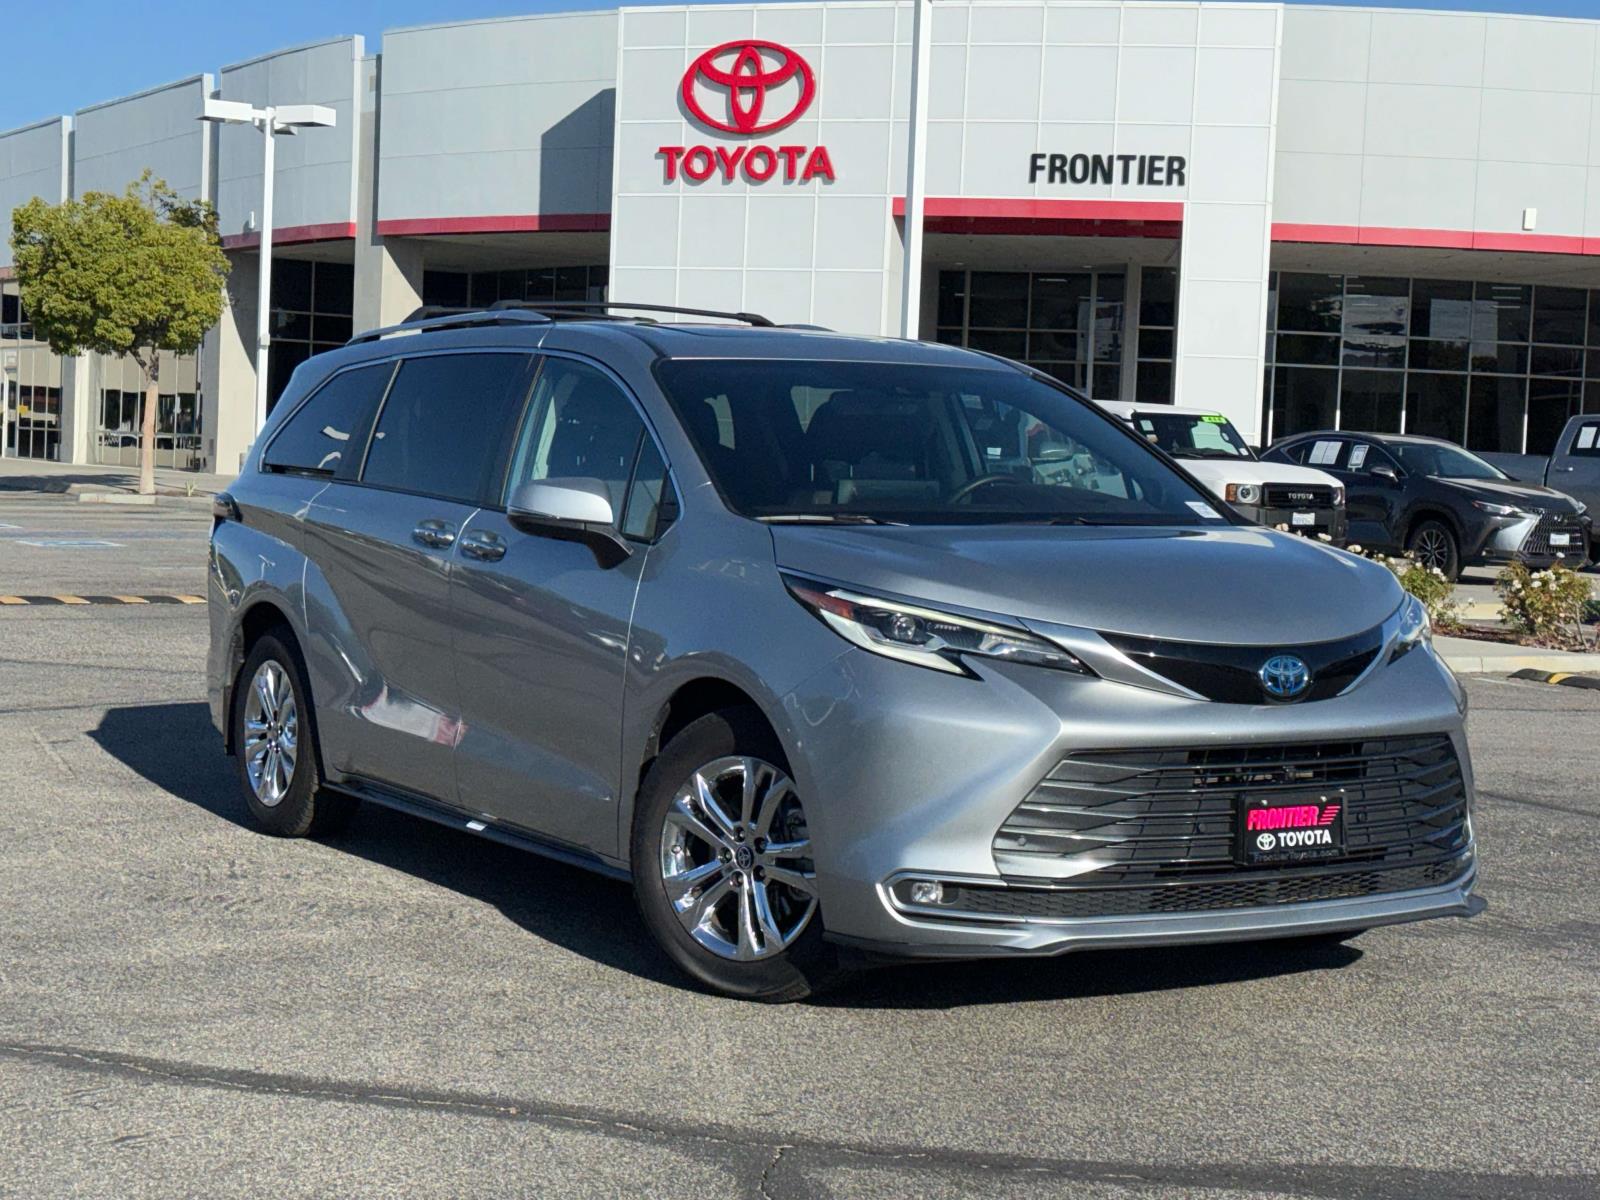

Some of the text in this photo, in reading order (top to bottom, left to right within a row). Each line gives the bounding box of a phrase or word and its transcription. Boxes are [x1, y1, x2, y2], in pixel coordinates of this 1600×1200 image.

[658, 146, 835, 182] TOYOTA
[1029, 153, 1186, 187] FRONTIER
[1247, 806, 1319, 830] FRONTIER
[1278, 829, 1332, 847] TOYOTA
